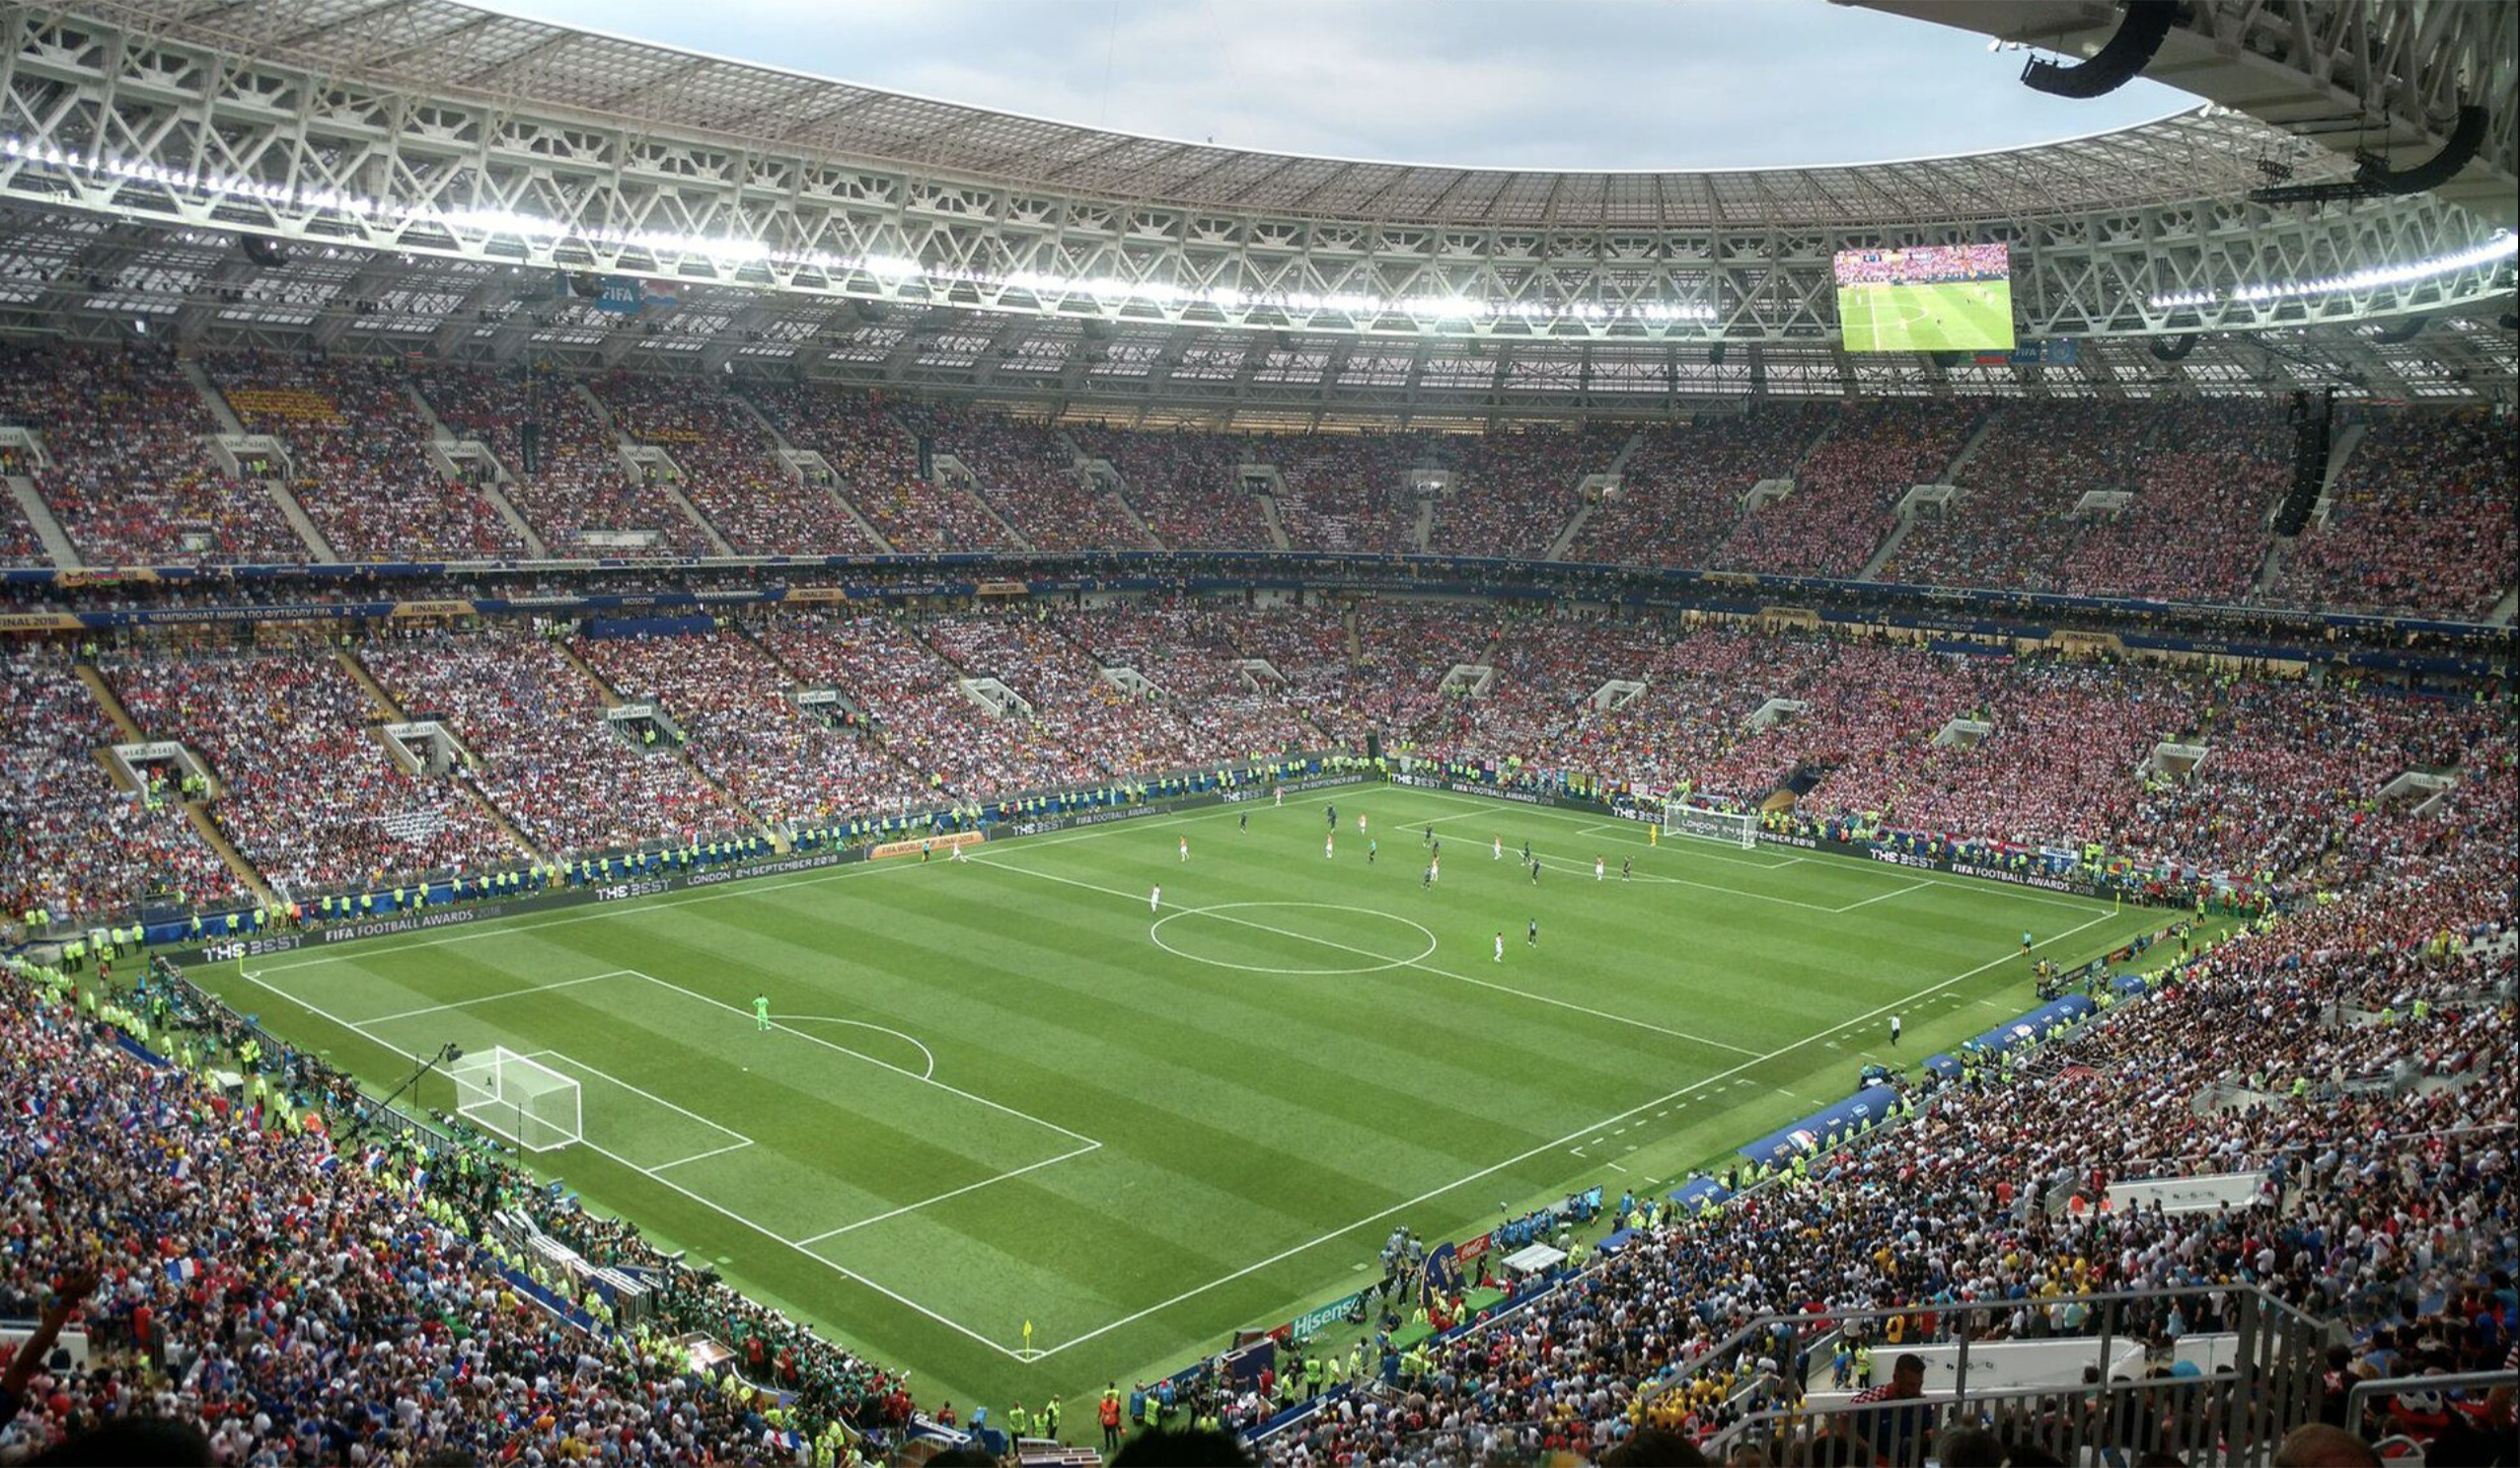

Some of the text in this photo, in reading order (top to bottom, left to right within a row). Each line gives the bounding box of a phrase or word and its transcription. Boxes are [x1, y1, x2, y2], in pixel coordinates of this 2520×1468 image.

[603, 286, 633, 303] FIFA
[149, 607, 334, 623] ЧЕМПИОНАТ МИРА ПО ФУТБОЛУ FIFA
[411, 605, 436, 614] FINAL
[0, 617, 30, 627] INAL
[1917, 620, 1932, 629] FIFA
[1933, 621, 1958, 631] WORLD
[2192, 642, 2228, 653] МОСКВА
[1391, 773, 1412, 785] THE
[1452, 783, 1467, 793] FIFA
[1467, 784, 1504, 798] FOOTBALL
[1507, 790, 1537, 803] AWARDS
[1075, 816, 1092, 826] FIFA
[1093, 812, 1127, 824] FOOTBALL
[1612, 806, 1636, 820] THE
[1013, 818, 1065, 836] THE BEST
[1682, 819, 1718, 832] LONDON
[1793, 837, 1816, 847] 2018
[1870, 848, 1938, 869] THE BEST
[687, 855, 838, 885] LONDON 24 SEPTEMBER 2018
[1952, 863, 2096, 896] FIFA FOOTBALL AWARDS 2018
[595, 879, 671, 901] THE BEST
[326, 905, 502, 942] FIFA FOOTBALL AWARDS 2018
[202, 934, 302, 963] THE BEST
